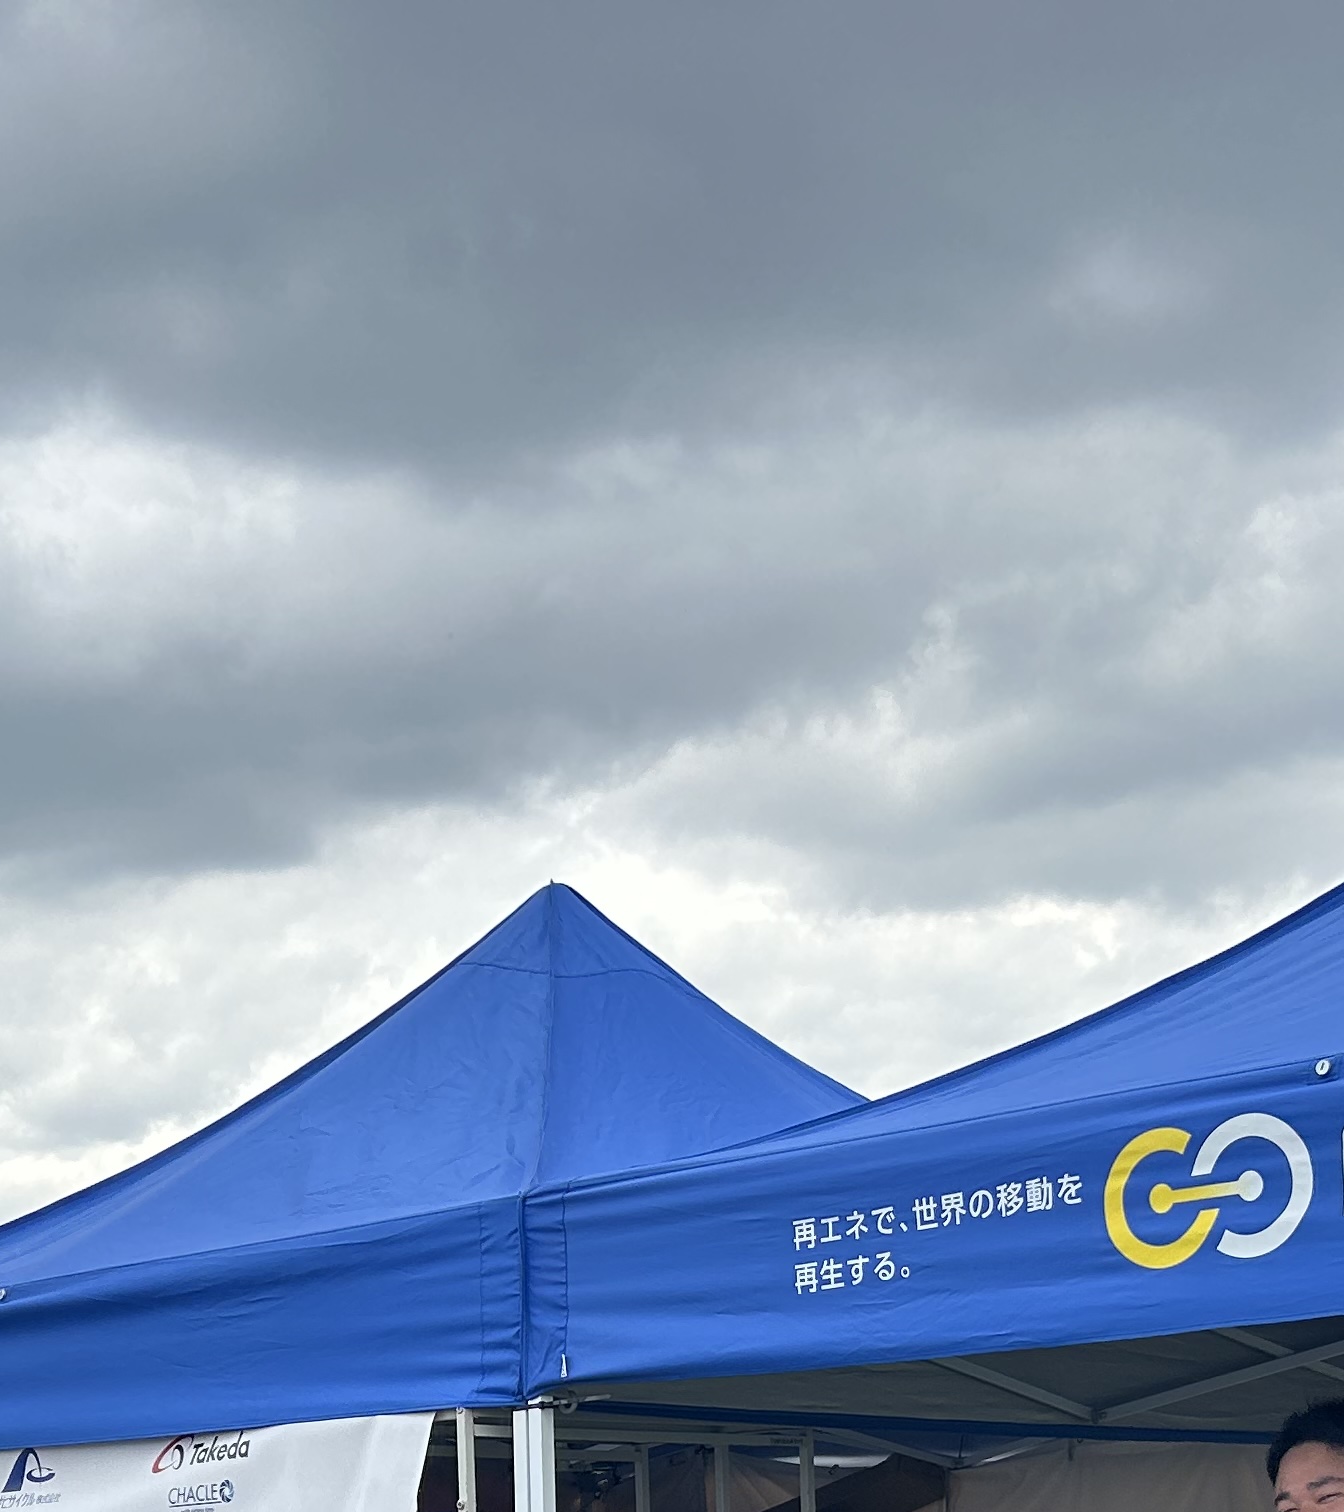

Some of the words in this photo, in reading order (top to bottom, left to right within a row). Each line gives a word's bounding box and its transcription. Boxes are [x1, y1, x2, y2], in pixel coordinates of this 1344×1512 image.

[793, 1172, 1083, 1252] 再エネで、世界の移動を
[794, 1251, 911, 1295] 再生する。
[190, 1430, 251, 1466] Takeda
[168, 1484, 218, 1505] CHACLE
